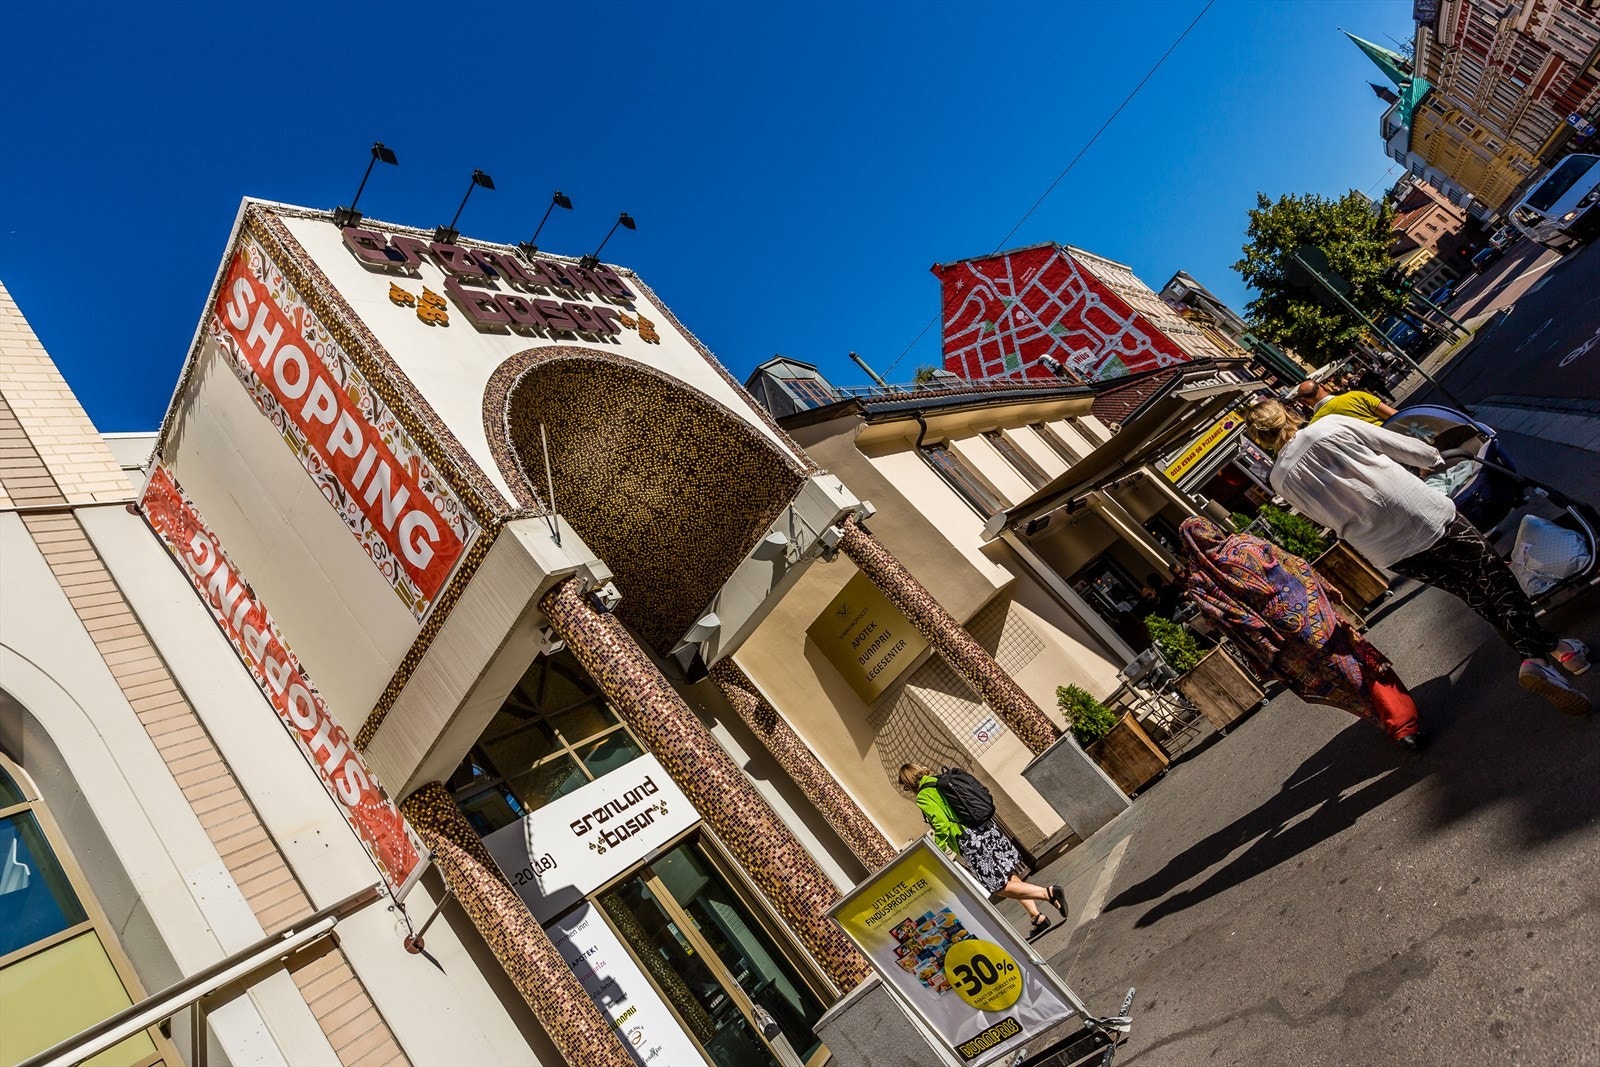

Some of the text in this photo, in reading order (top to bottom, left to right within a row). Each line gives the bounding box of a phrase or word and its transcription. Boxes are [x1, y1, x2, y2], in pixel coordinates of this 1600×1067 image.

[444, 276, 622, 337] basar
[225, 276, 440, 571] SHOPPING
[1170, 427, 1223, 476] OSLO KEBAB OG PIZZAHUS
[851, 621, 878, 649] APOTEK
[186, 531, 368, 805] SHOPPING
[866, 639, 907, 682] LEGESENTER
[600, 807, 655, 848] basar
[512, 853, 558, 887] -20(18)
[865, 878, 928, 927] FINDUSPRODUKTER
[872, 881, 908, 910] UTVALGTE
[555, 929, 578, 947] ommen
[959, 1018, 1019, 1058] BUNNPRIS
